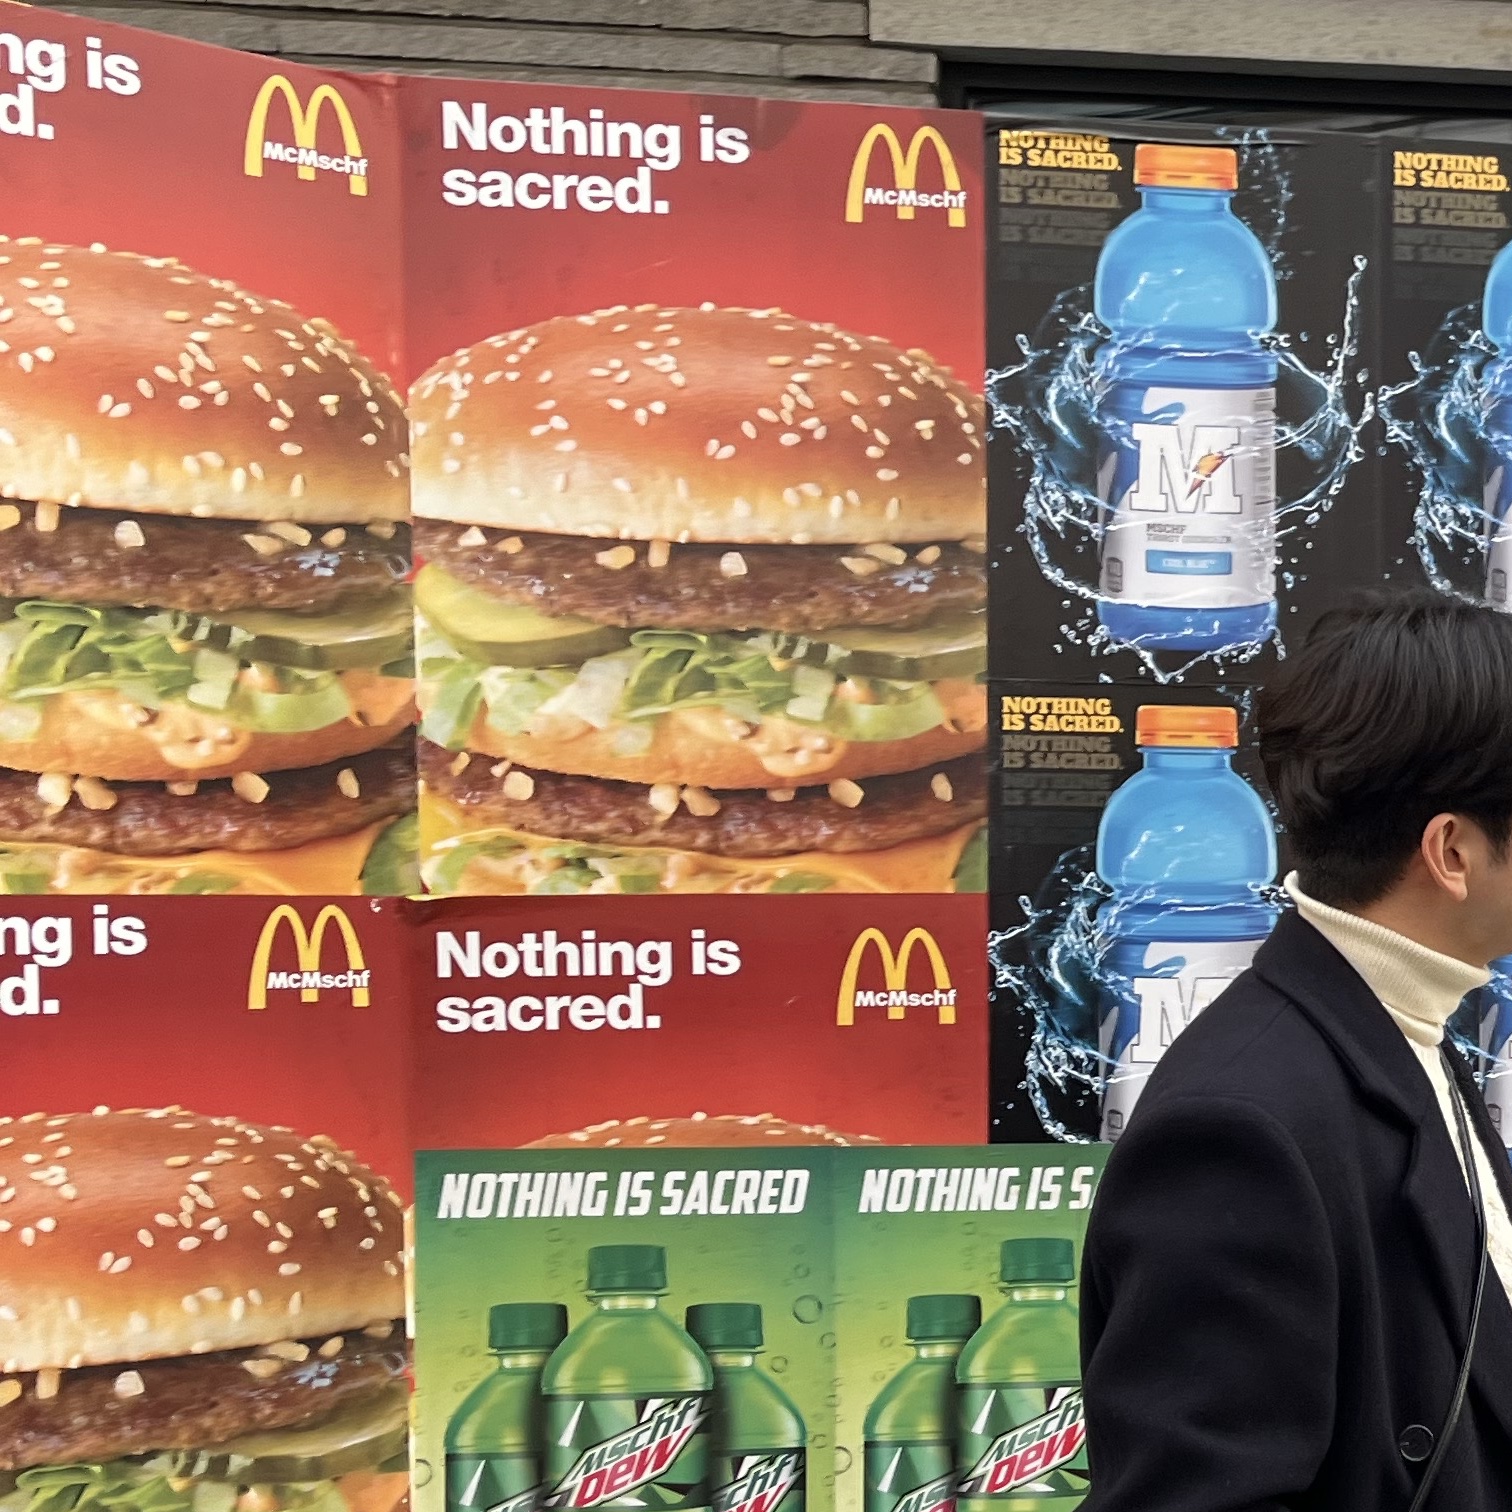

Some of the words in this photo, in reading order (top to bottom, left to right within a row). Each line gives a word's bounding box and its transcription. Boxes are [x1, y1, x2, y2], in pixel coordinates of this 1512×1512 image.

[86, 37, 141, 96] is
[441, 101, 681, 171] Nothing
[698, 113, 750, 164] is
[263, 141, 368, 178] McMschf
[999, 148, 1022, 166] IS
[1027, 150, 1122, 171] SACRED.
[1394, 152, 1499, 175] NOTHING
[441, 163, 670, 214] sacred.
[863, 188, 967, 209] McMschf
[1394, 170, 1416, 187] IS
[1420, 172, 1511, 192] SACRED.
[1001, 696, 1112, 716] NOTHING
[1001, 714, 1025, 731] IS
[1029, 715, 1125, 733] SACRED.
[93, 904, 148, 955] is
[436, 930, 673, 985] Nothing
[690, 928, 741, 974] is
[266, 968, 371, 990] McMschf
[436, 983, 662, 1033] sacred.
[855, 988, 957, 1008] McMschf
[437, 1171, 608, 1219] NOTHING
[613, 1170, 654, 1217] IS
[659, 1169, 810, 1217] SACRED
[858, 1167, 1021, 1213] NOTHING
[1025, 1166, 1065, 1211] IS
